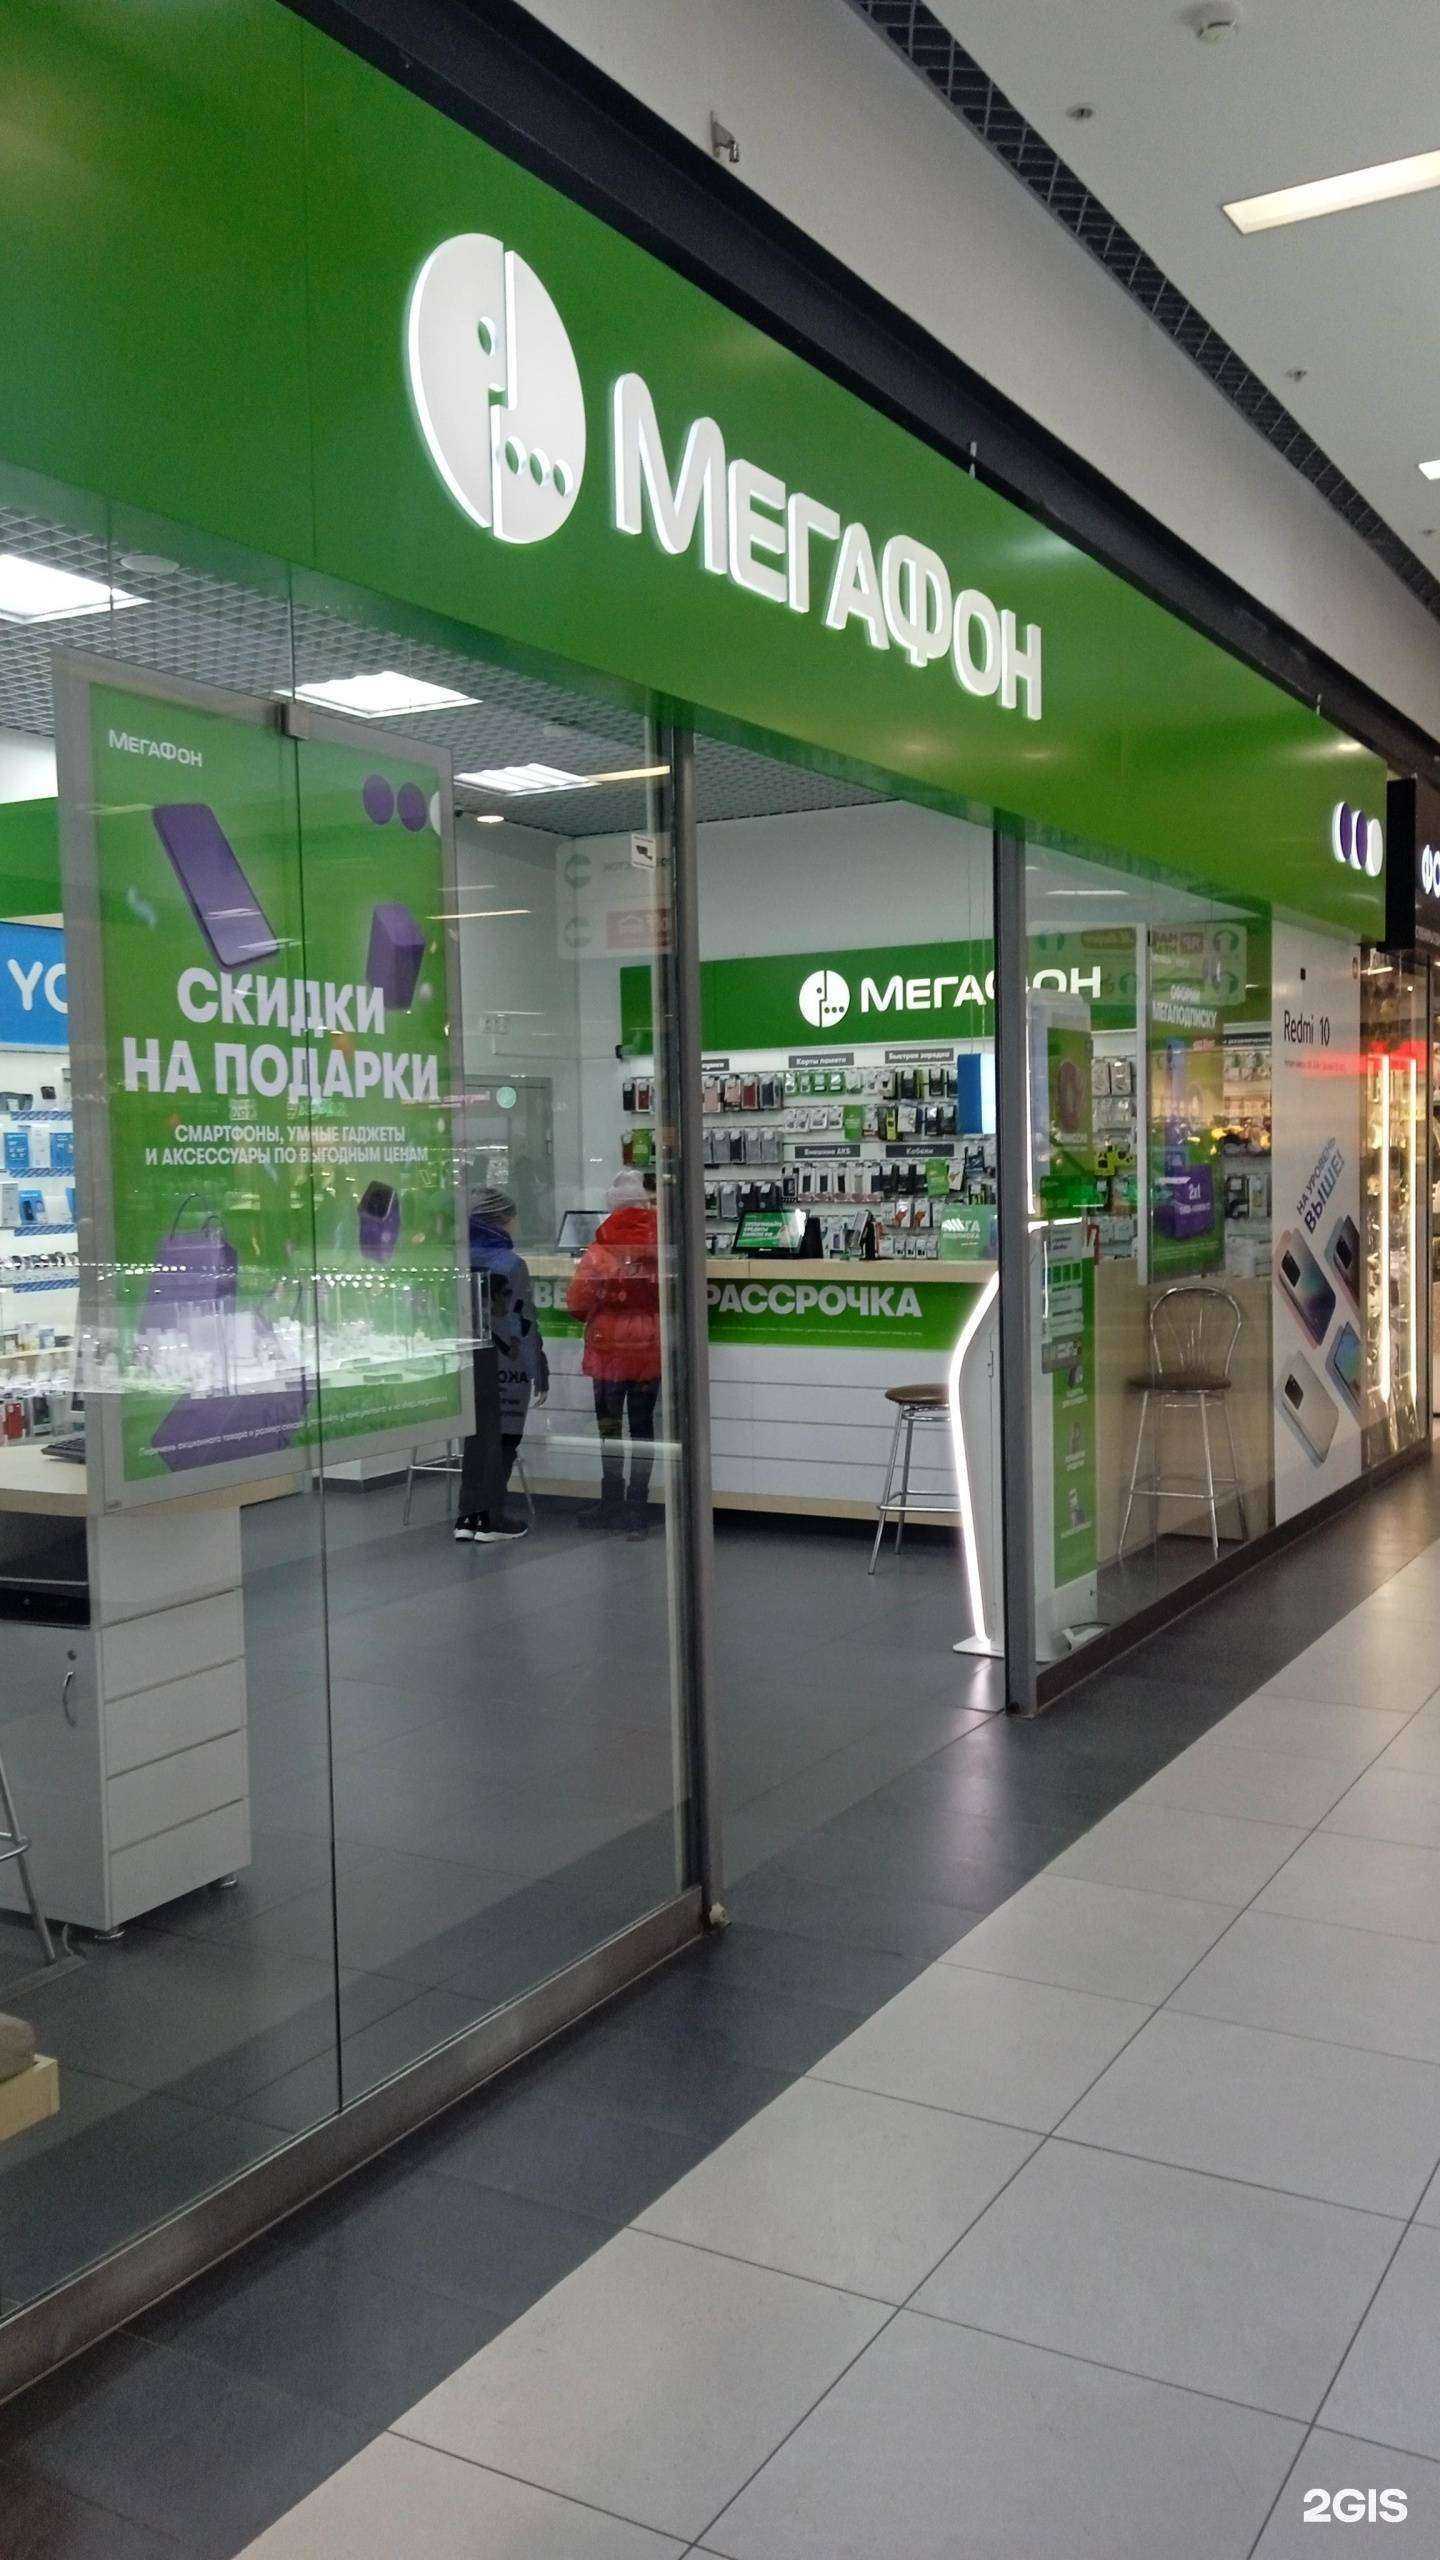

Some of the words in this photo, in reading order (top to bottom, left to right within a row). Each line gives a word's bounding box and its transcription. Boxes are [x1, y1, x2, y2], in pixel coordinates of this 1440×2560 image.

[613, 372, 1042, 720] МЕГАФОН
[108, 729, 203, 767] МЕГАФОН
[7, 958, 68, 1014] YO
[176, 966, 386, 1038] СКИДКИ
[1284, 1009, 1313, 1044] Redmi
[1320, 1015, 1330, 1047] 10
[122, 1036, 201, 1095] НА
[214, 1043, 440, 1104] ПОДАРКИ
[174, 1124, 284, 1145] СМАРТФОНЫ,
[287, 1126, 339, 1143] УМНЫЕ
[342, 1126, 405, 1144] ГАДЖЕТЫ
[145, 1148, 158, 1166] И
[161, 1147, 271, 1166] АКСЕССУАРЫ
[274, 1148, 296, 1165] ПО
[299, 1147, 381, 1164] ВЫГОДНЫМ
[384, 1147, 429, 1164] ЦЕНАМ
[707, 1283, 923, 1319] РАССРОЧКА
